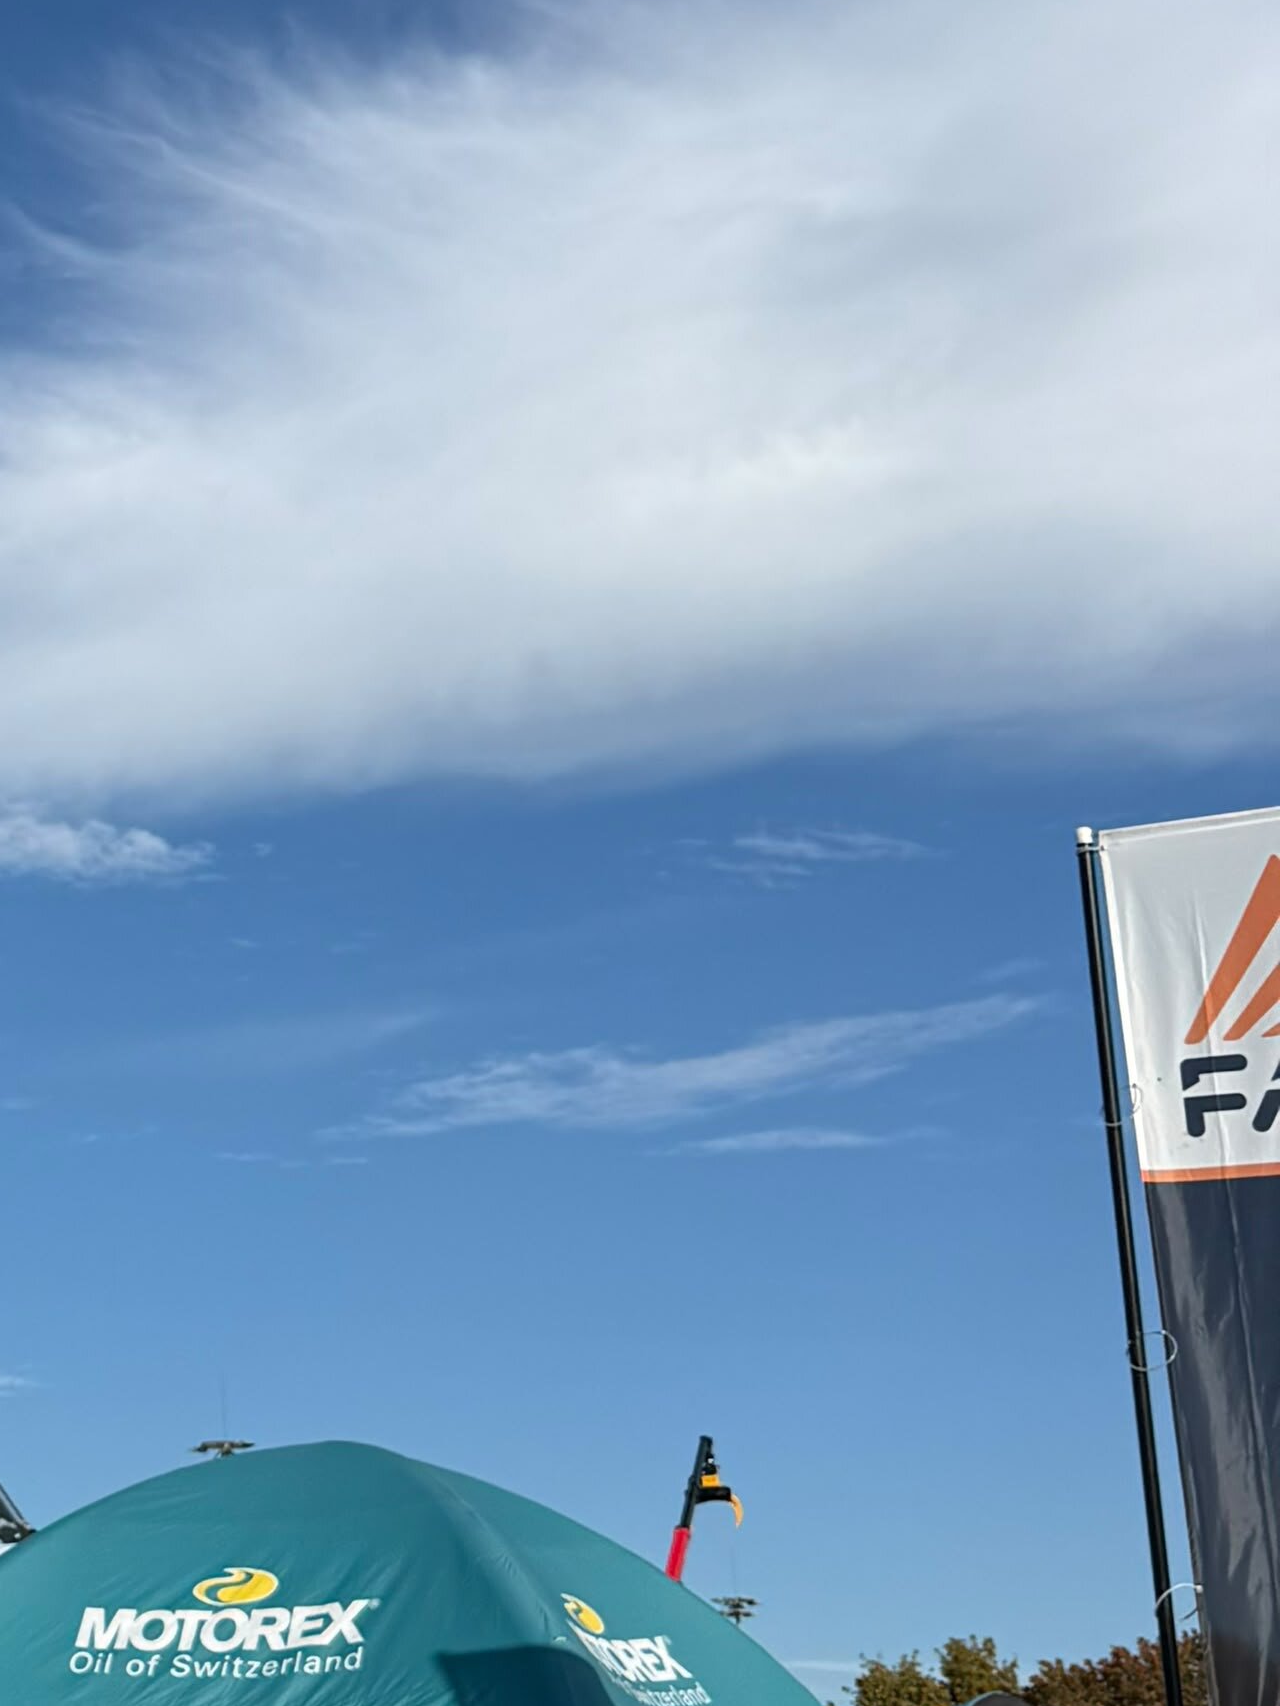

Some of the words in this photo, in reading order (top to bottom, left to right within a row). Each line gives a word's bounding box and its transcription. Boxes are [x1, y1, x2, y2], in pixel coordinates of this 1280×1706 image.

[73, 1599, 371, 1653] MOTOREX
[69, 1650, 113, 1675] Oil
[125, 1654, 162, 1677] of
[170, 1646, 364, 1679] Switzerland
